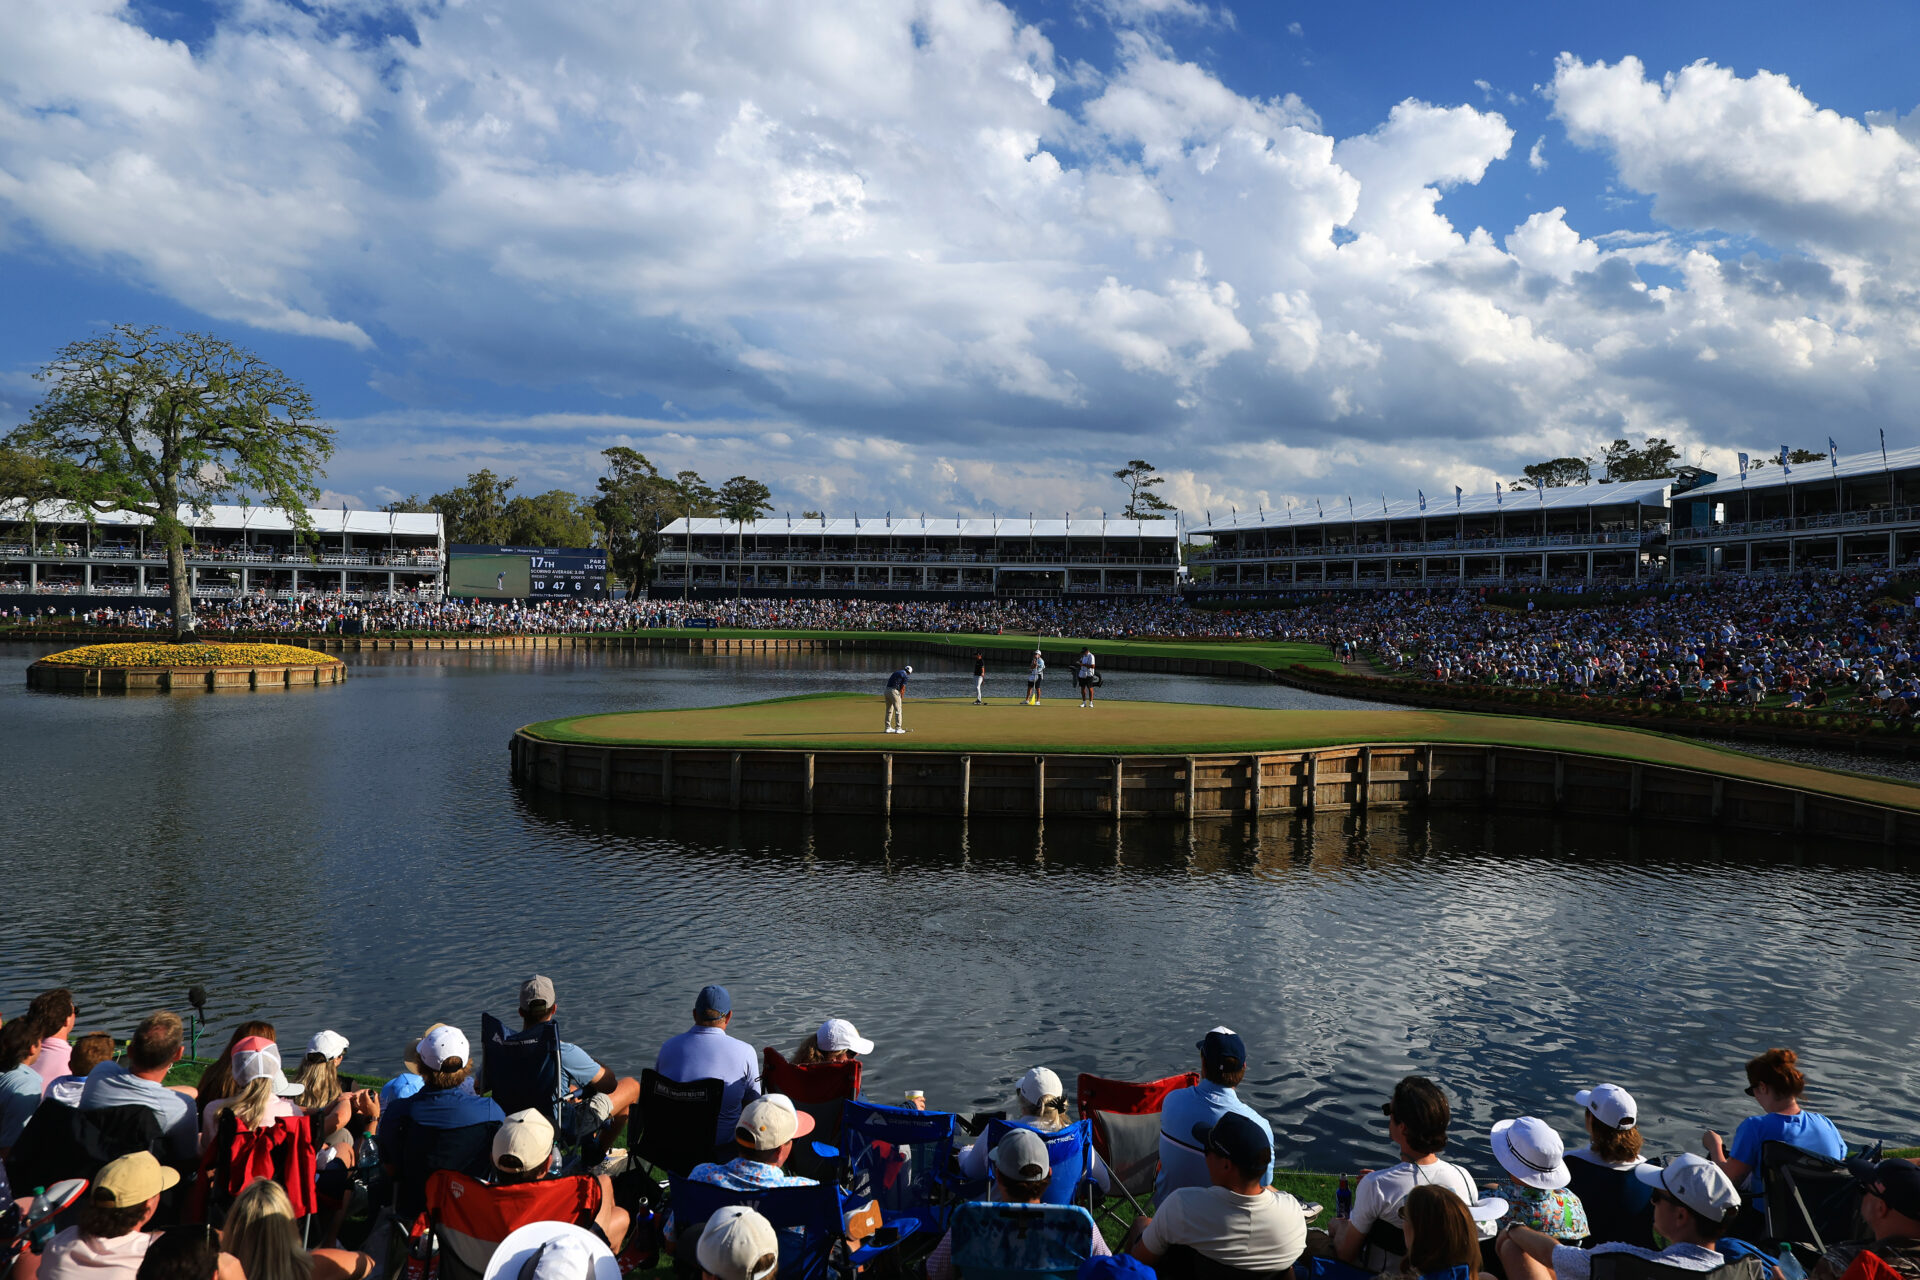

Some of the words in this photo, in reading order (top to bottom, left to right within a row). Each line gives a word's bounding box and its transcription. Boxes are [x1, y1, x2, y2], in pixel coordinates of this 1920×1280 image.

[530, 556, 555, 568] 17TH
[534, 581, 545, 590] 10
[552, 581, 565, 590] 47
[575, 582, 582, 591] 6
[593, 583, 601, 591] 4
